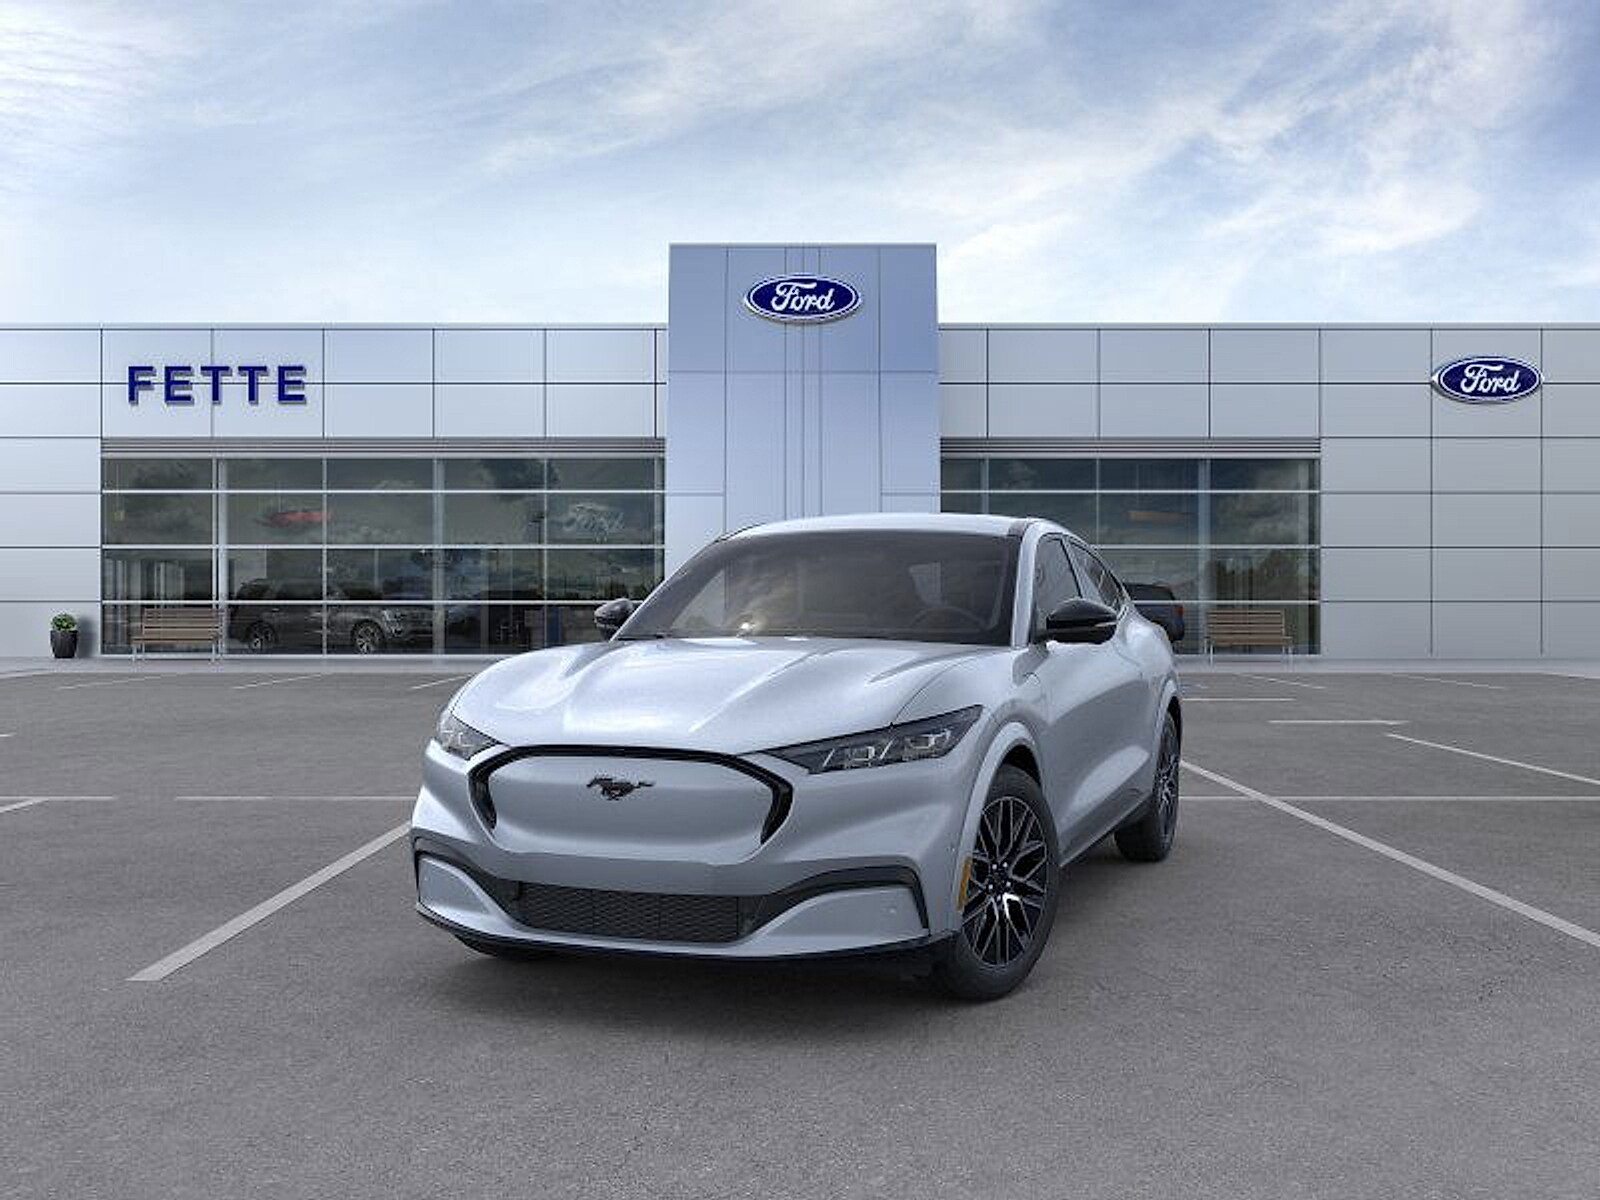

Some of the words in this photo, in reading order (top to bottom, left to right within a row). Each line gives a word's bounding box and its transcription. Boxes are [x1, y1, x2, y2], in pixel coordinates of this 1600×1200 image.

[771, 281, 835, 311] Ford
[128, 365, 306, 404] FETTE
[1460, 364, 1521, 393] Ford
